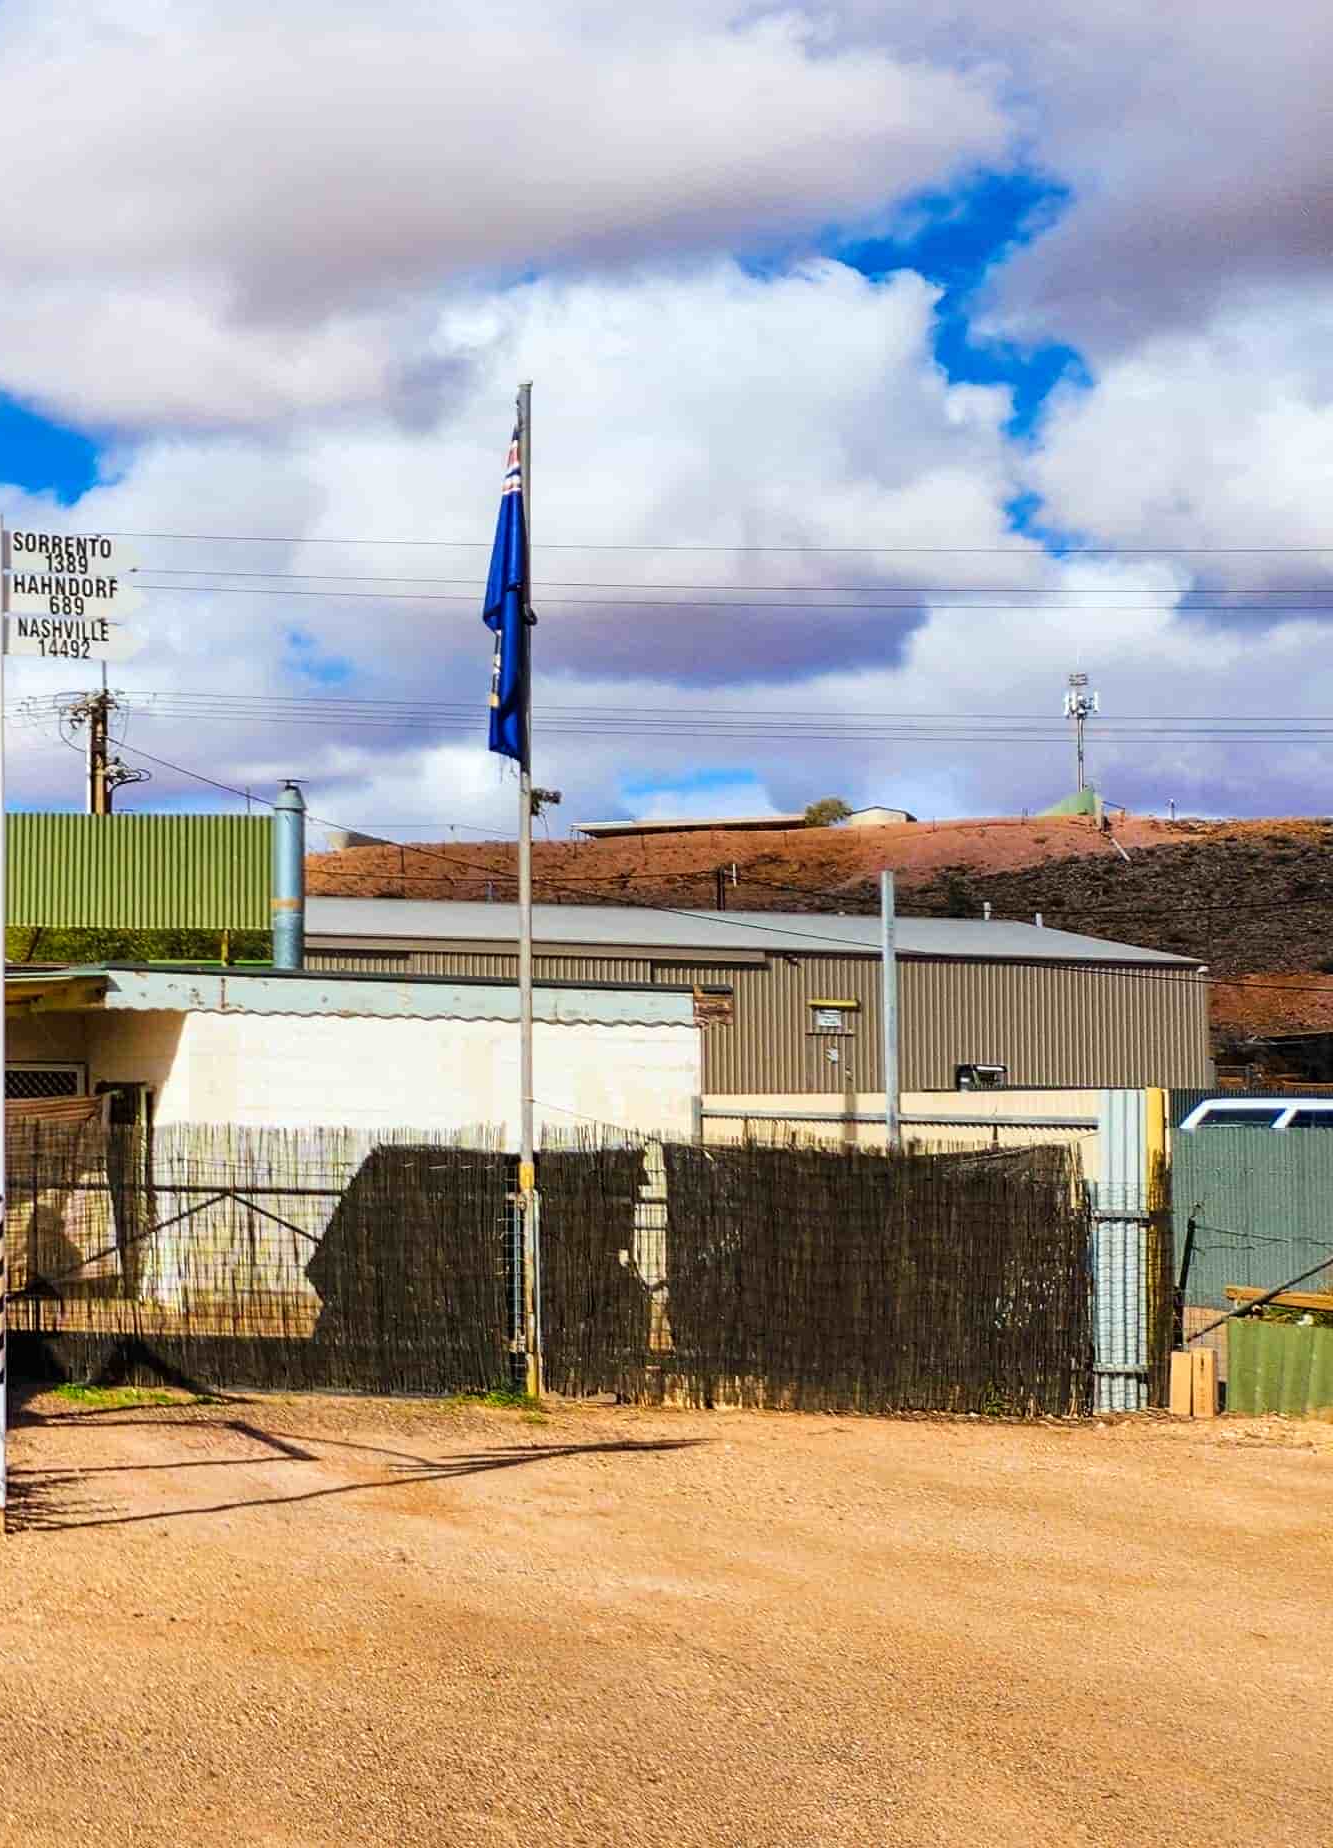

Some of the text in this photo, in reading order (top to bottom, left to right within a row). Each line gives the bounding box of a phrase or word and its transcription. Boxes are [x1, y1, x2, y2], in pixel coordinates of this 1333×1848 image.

[13, 532, 111, 558] SORRENTO
[45, 552, 88, 574] 1389
[13, 574, 117, 599] HAHNDORF
[49, 595, 85, 616] 689
[18, 616, 110, 642] NASHVILLE
[38, 639, 91, 660] 14492
